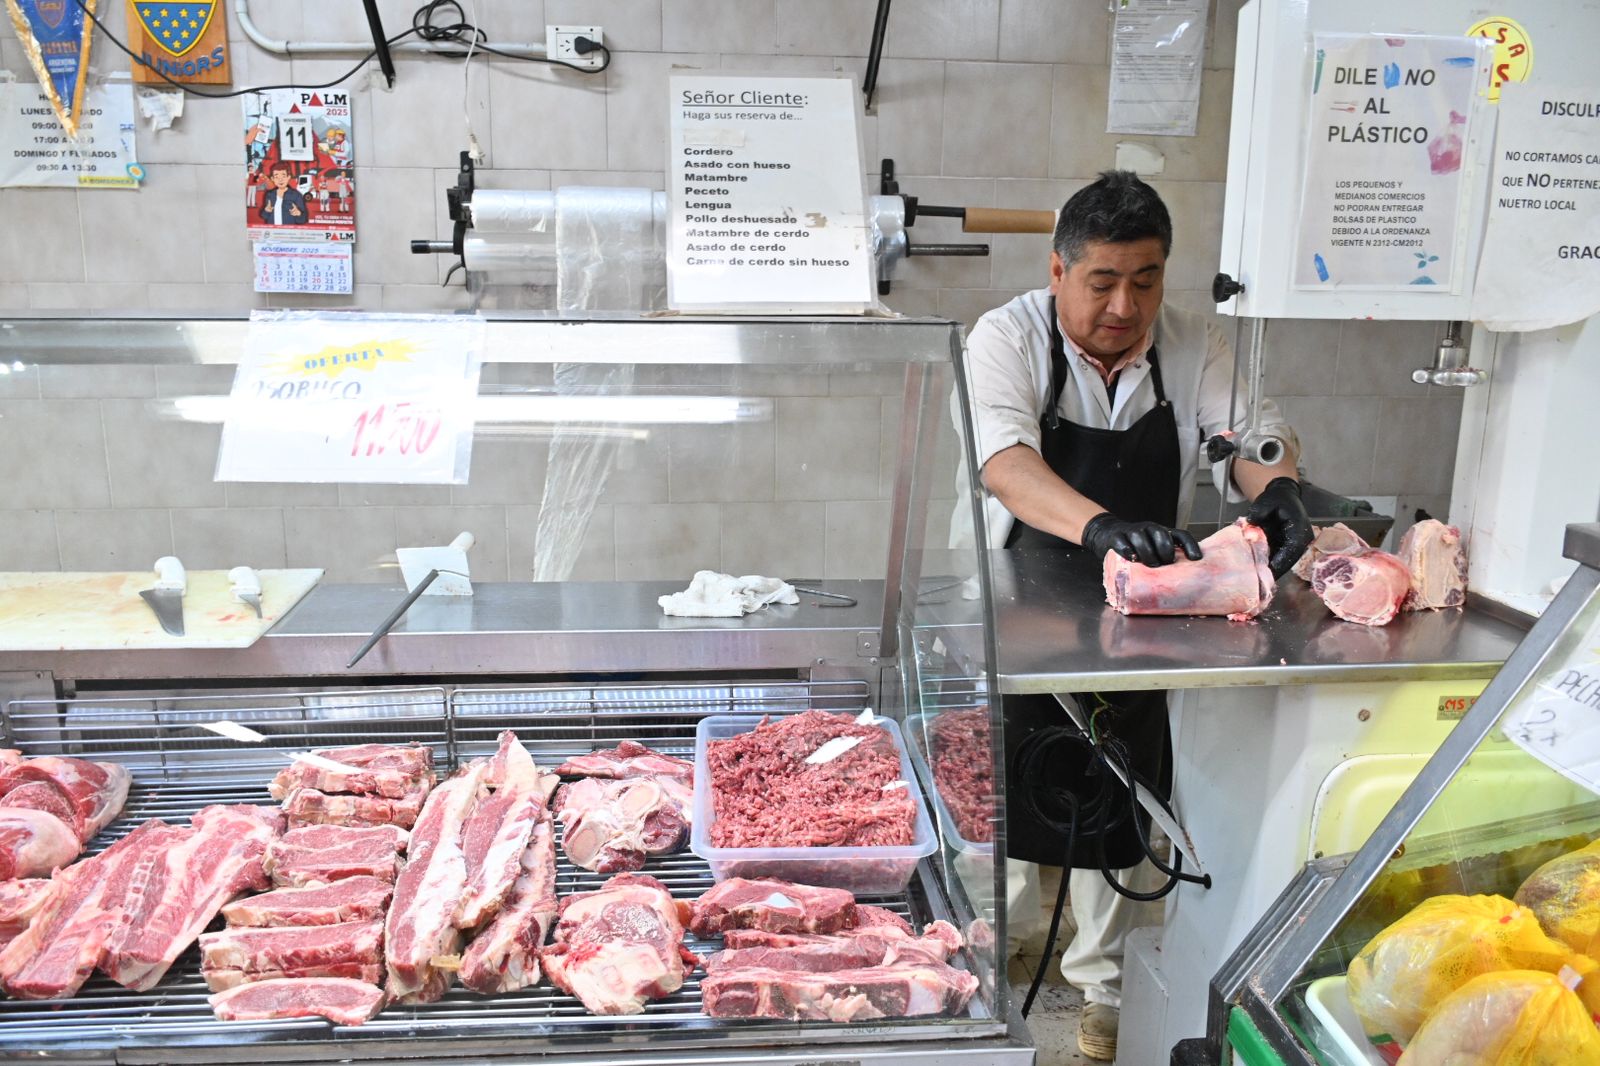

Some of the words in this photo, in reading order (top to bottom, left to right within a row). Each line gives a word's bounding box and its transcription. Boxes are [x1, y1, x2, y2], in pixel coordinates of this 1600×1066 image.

[1334, 67, 1377, 85] DILE
[1405, 68, 1436, 86] NO
[301, 92, 347, 107] PALM
[682, 90, 735, 104] Señor
[740, 91, 808, 105] Cliente:
[1363, 97, 1391, 114] AL
[21, 108, 52, 116] LUNES
[326, 108, 348, 116] 2025
[683, 111, 711, 121] Haga
[714, 112, 733, 120] sus
[735, 112, 777, 120] reserva
[779, 112, 803, 120] de...
[32, 122, 57, 130] 09:00
[286, 126, 307, 148] 11
[1328, 122, 1429, 144] PLÁSTICO
[14, 150, 58, 158] DOMINGO
[684, 147, 734, 156] Cordero
[1505, 151, 1521, 161] NO
[1523, 152, 1583, 164] CORTAMOS
[1585, 154, 1600, 165] CA
[684, 160, 723, 169] Asado
[753, 161, 791, 169] hueso
[684, 173, 748, 182] Matambre
[1502, 176, 1523, 187] QUE
[1526, 173, 1551, 188] NO
[685, 187, 729, 195] Peceto
[685, 201, 732, 211] Lengua
[1333, 204, 1345, 212] NO
[1346, 204, 1380, 212] PODRAN
[1381, 204, 1424, 212] ENTREGAR
[1499, 198, 1541, 209] NUETRO
[1544, 200, 1577, 210] LOCAL
[686, 214, 717, 223] Pollo
[721, 215, 797, 224] deshuesado
[686, 229, 750, 237] Matambre
[754, 229, 769, 237] de
[773, 229, 810, 237] cerdo
[1331, 227, 1361, 235] DEBIDO
[686, 243, 726, 252] Asado
[730, 243, 745, 251] de
[749, 243, 786, 252] cerdo
[1373, 239, 1423, 247] 2312-CM2012
[728, 257, 744, 266] de
[748, 257, 785, 266] cerdo
[788, 257, 807, 266] sin
[811, 258, 850, 267] hueso
[1445, 699, 1465, 711] MS
